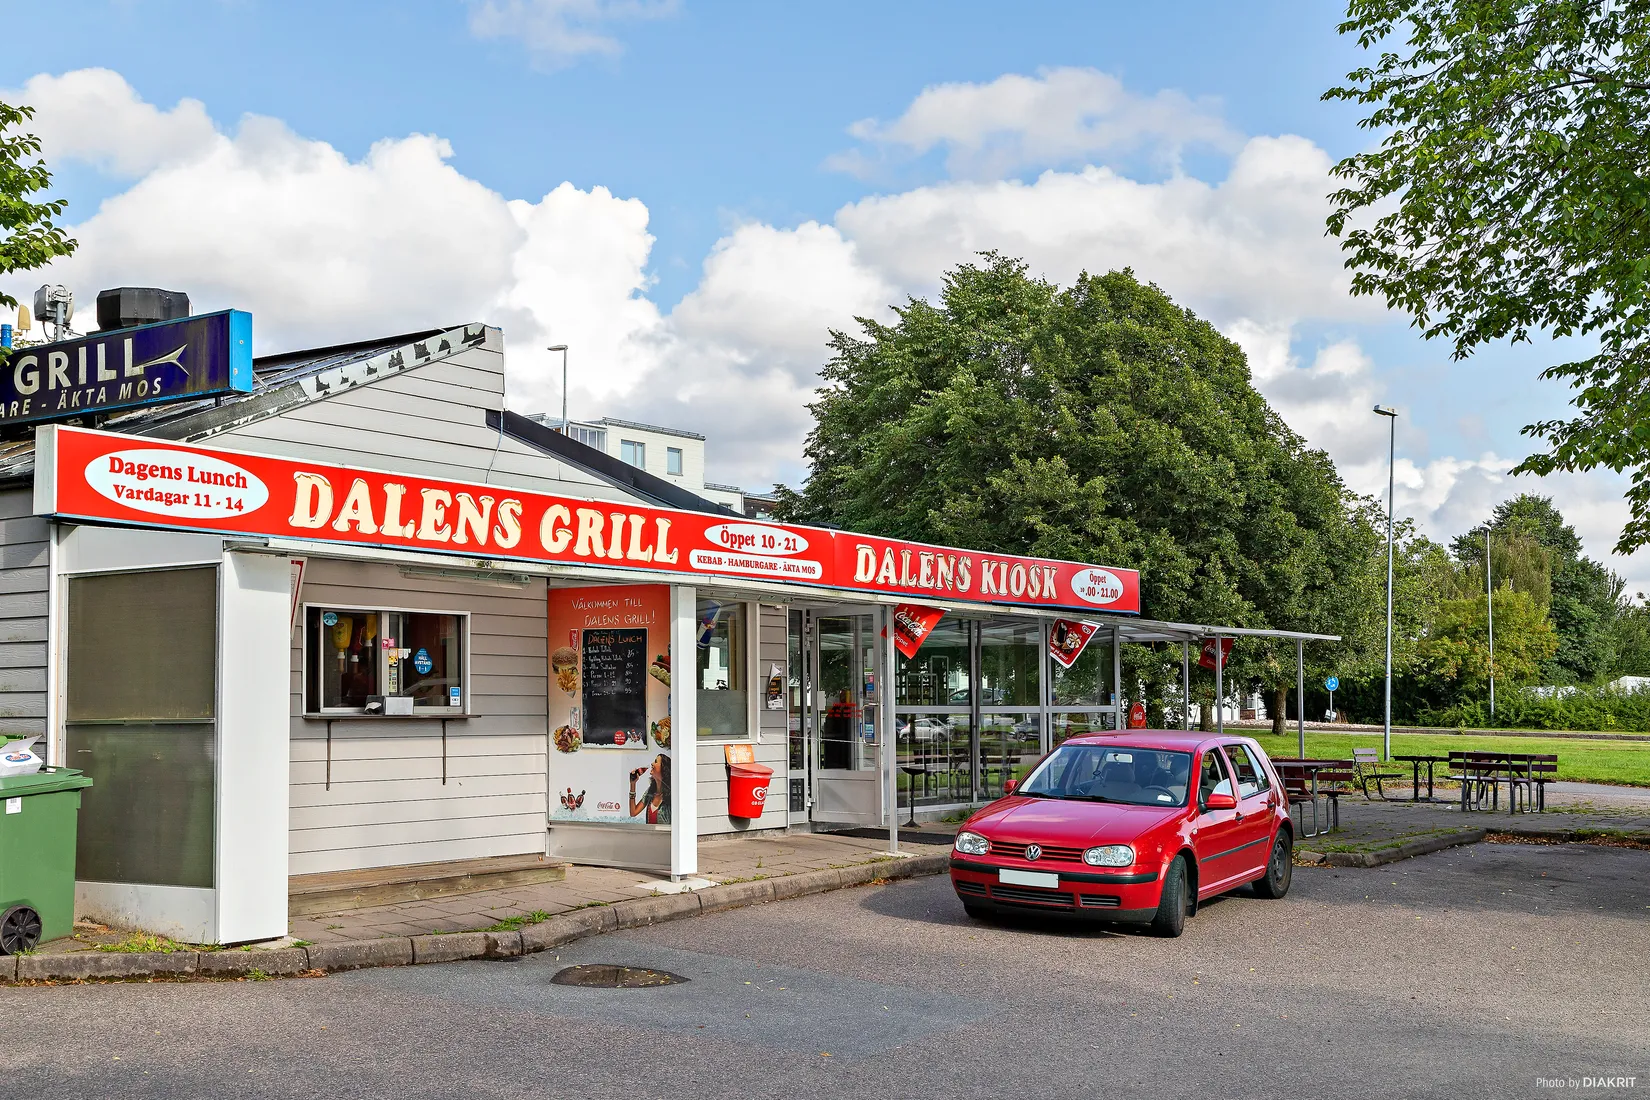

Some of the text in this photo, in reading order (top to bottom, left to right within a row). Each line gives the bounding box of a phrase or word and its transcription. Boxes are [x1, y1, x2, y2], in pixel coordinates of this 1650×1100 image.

[13, 337, 144, 395] GRILL
[57, 386, 107, 410] ÄKTA
[118, 377, 162, 400] MOS
[109, 456, 248, 489] Dagens Lunch
[113, 484, 190, 506] Vardagar
[194, 493, 212, 507] 11
[225, 497, 244, 512] 14
[287, 470, 678, 565] DALENS GRILL
[720, 525, 756, 549] Öppet
[761, 534, 775, 549] 10
[784, 537, 798, 551] 21
[696, 555, 723, 565] KEBAB
[728, 558, 778, 571] HAMBURGARE
[782, 561, 800, 573] ÄKTA
[801, 565, 816, 575] MOS
[853, 543, 1058, 600] DALENS KIOSK
[1089, 570, 1107, 585] Öppet
[624, 598, 643, 607] TILL
[1100, 587, 1119, 599] 21.00
[584, 609, 655, 627] DALENS GRILL!
